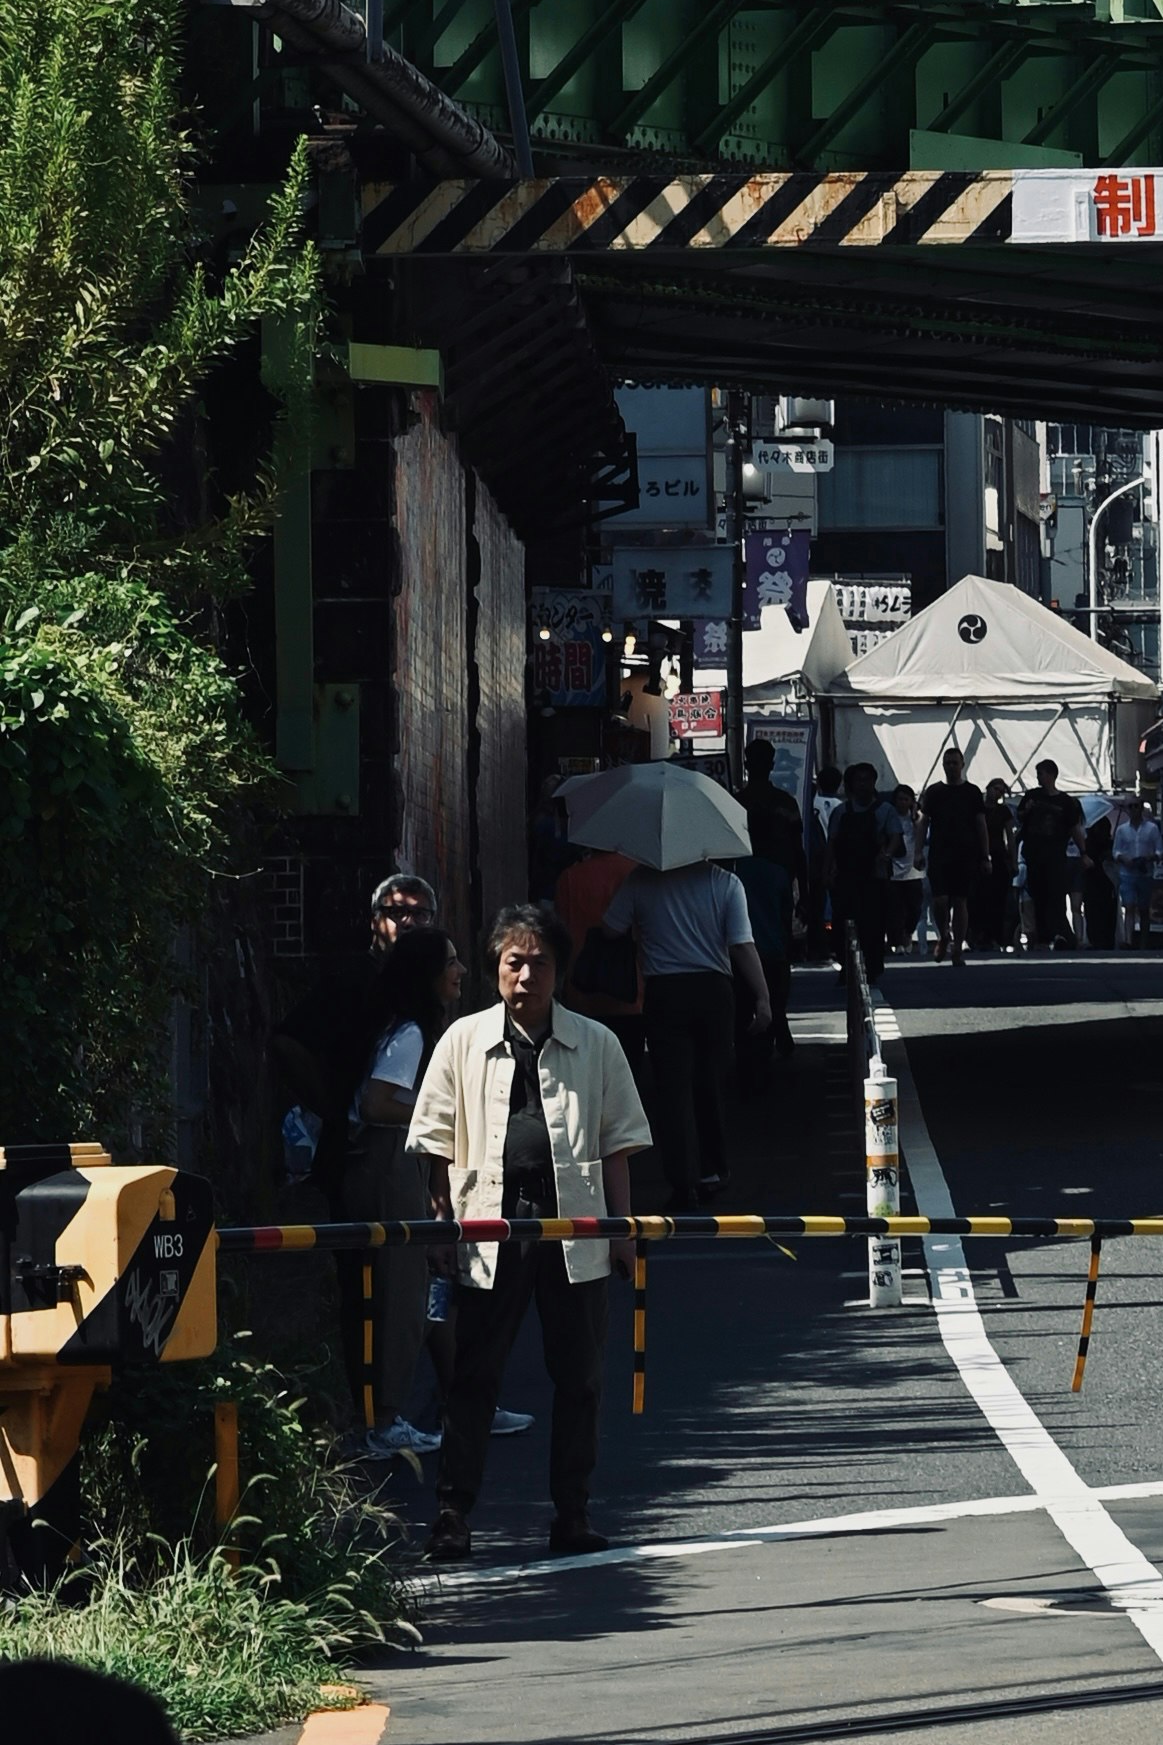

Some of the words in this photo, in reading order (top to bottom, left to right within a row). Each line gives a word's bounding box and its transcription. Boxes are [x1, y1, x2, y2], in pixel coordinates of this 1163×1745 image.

[758, 450, 829, 464] 代々木商店街
[534, 642, 592, 692] 時間
[153, 1233, 184, 1259] WB3
